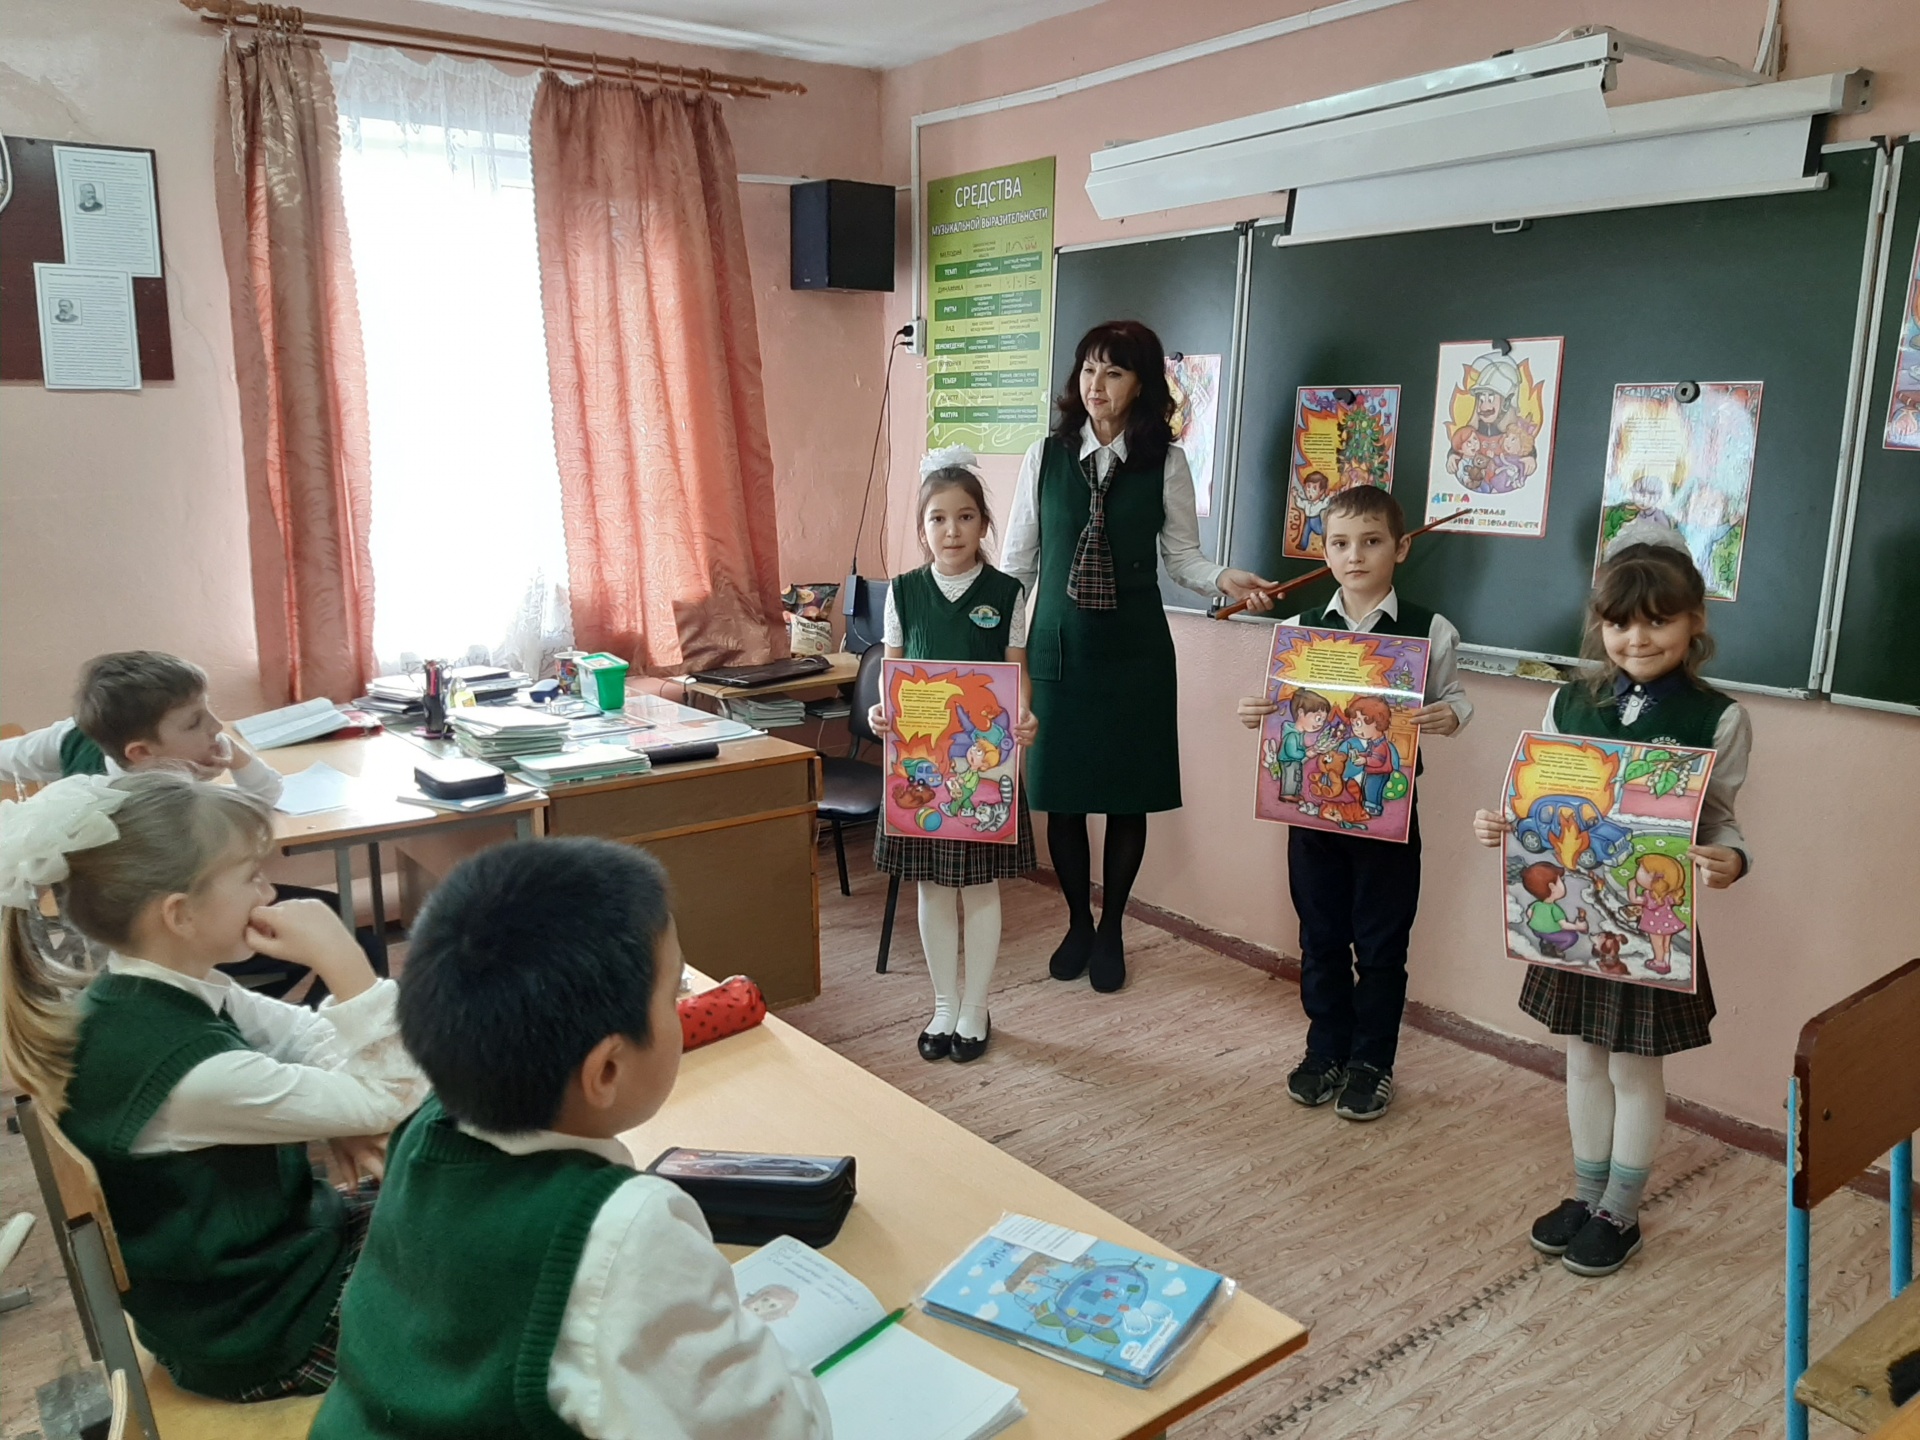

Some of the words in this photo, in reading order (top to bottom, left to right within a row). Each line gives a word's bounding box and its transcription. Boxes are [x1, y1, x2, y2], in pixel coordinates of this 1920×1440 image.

[955, 177, 1022, 209] СРЕДСТВА
[931, 217, 980, 237] МУЗЫКАЛЬНОЙ
[981, 208, 1049, 229] ВЫРАЗИТЕЛЬНОСТИ
